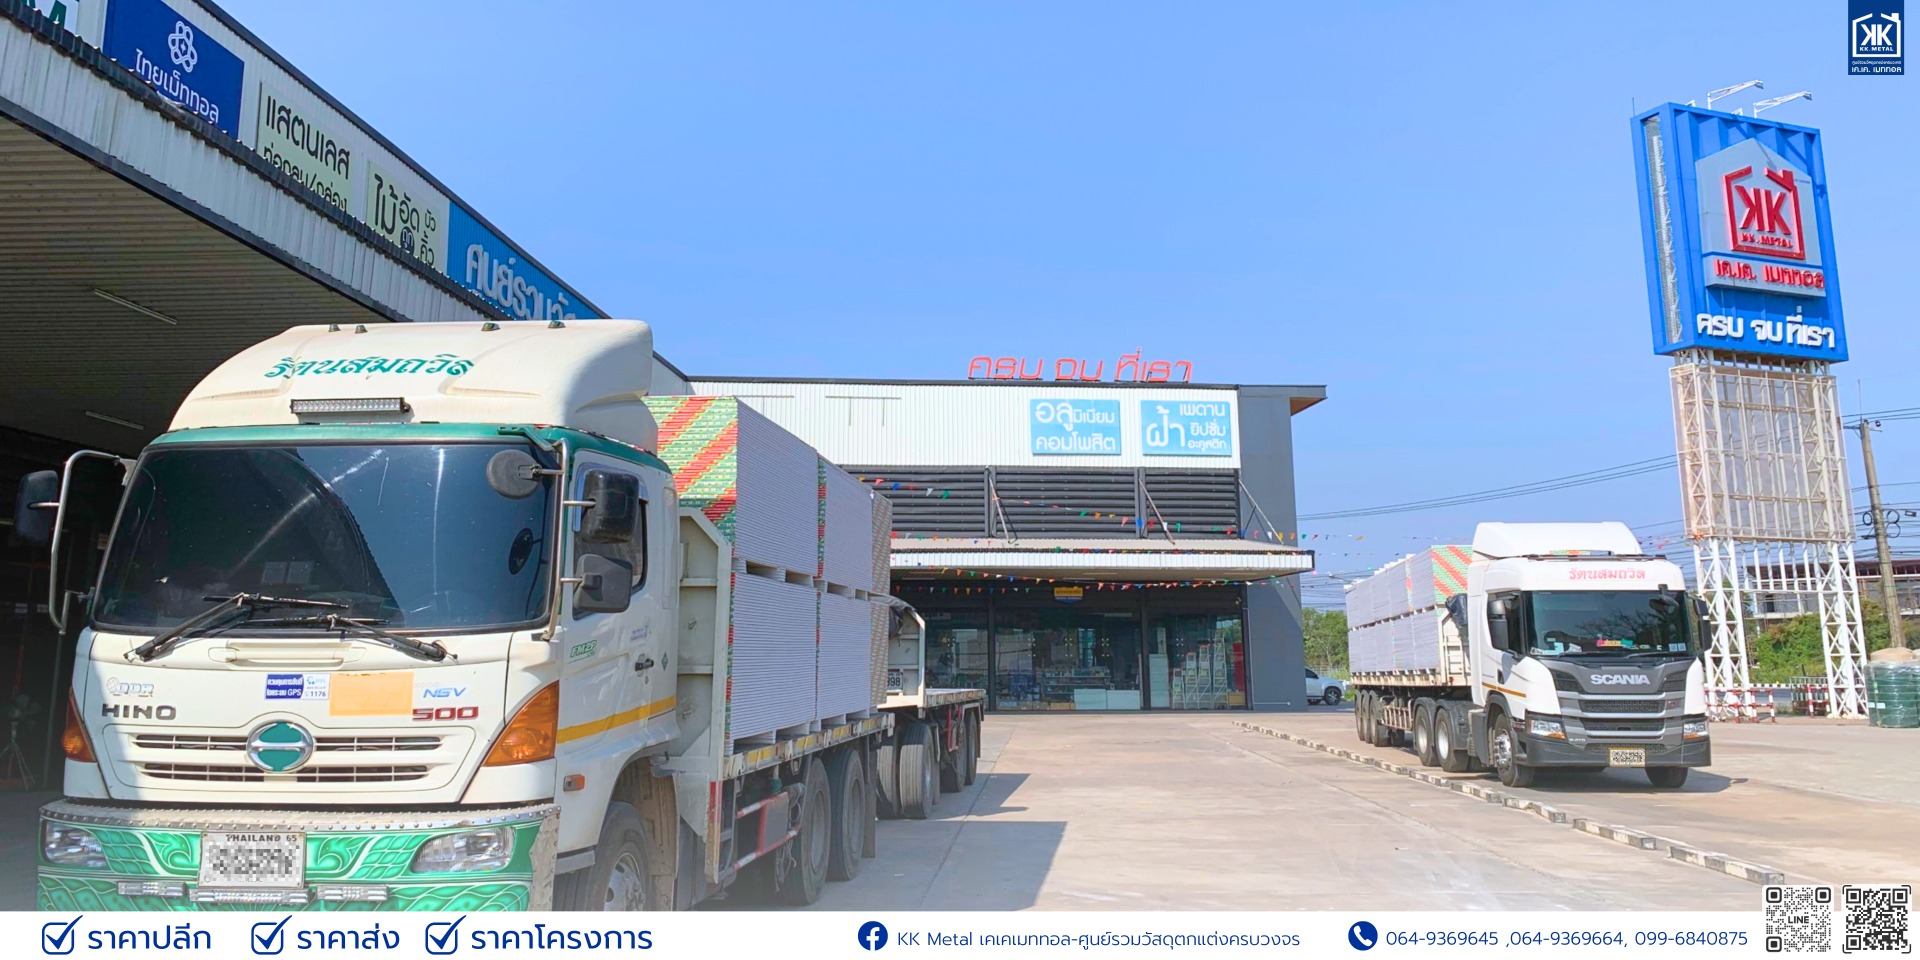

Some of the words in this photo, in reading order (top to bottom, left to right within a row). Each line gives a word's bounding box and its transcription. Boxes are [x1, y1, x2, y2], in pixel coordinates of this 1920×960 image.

[266, 95, 351, 181] แสตนเลส
[1762, 264, 1826, 289] เมททอล
[1696, 312, 1744, 339] ครบ
[1750, 319, 1783, 344] จบ
[1785, 305, 1836, 349] ที่เรา
[967, 355, 1044, 381] ครบ
[1055, 357, 1104, 382] จบ
[1113, 346, 1193, 384] ที่เรา
[1179, 402, 1227, 418] เพดาน
[1146, 404, 1186, 448] ฝ้า
[1035, 431, 1116, 452] คอมโพสิต
[1590, 673, 1651, 686] SCANIA
[101, 703, 177, 721] HINO
[412, 706, 479, 722] 500
[226, 834, 281, 842] THAILAND
